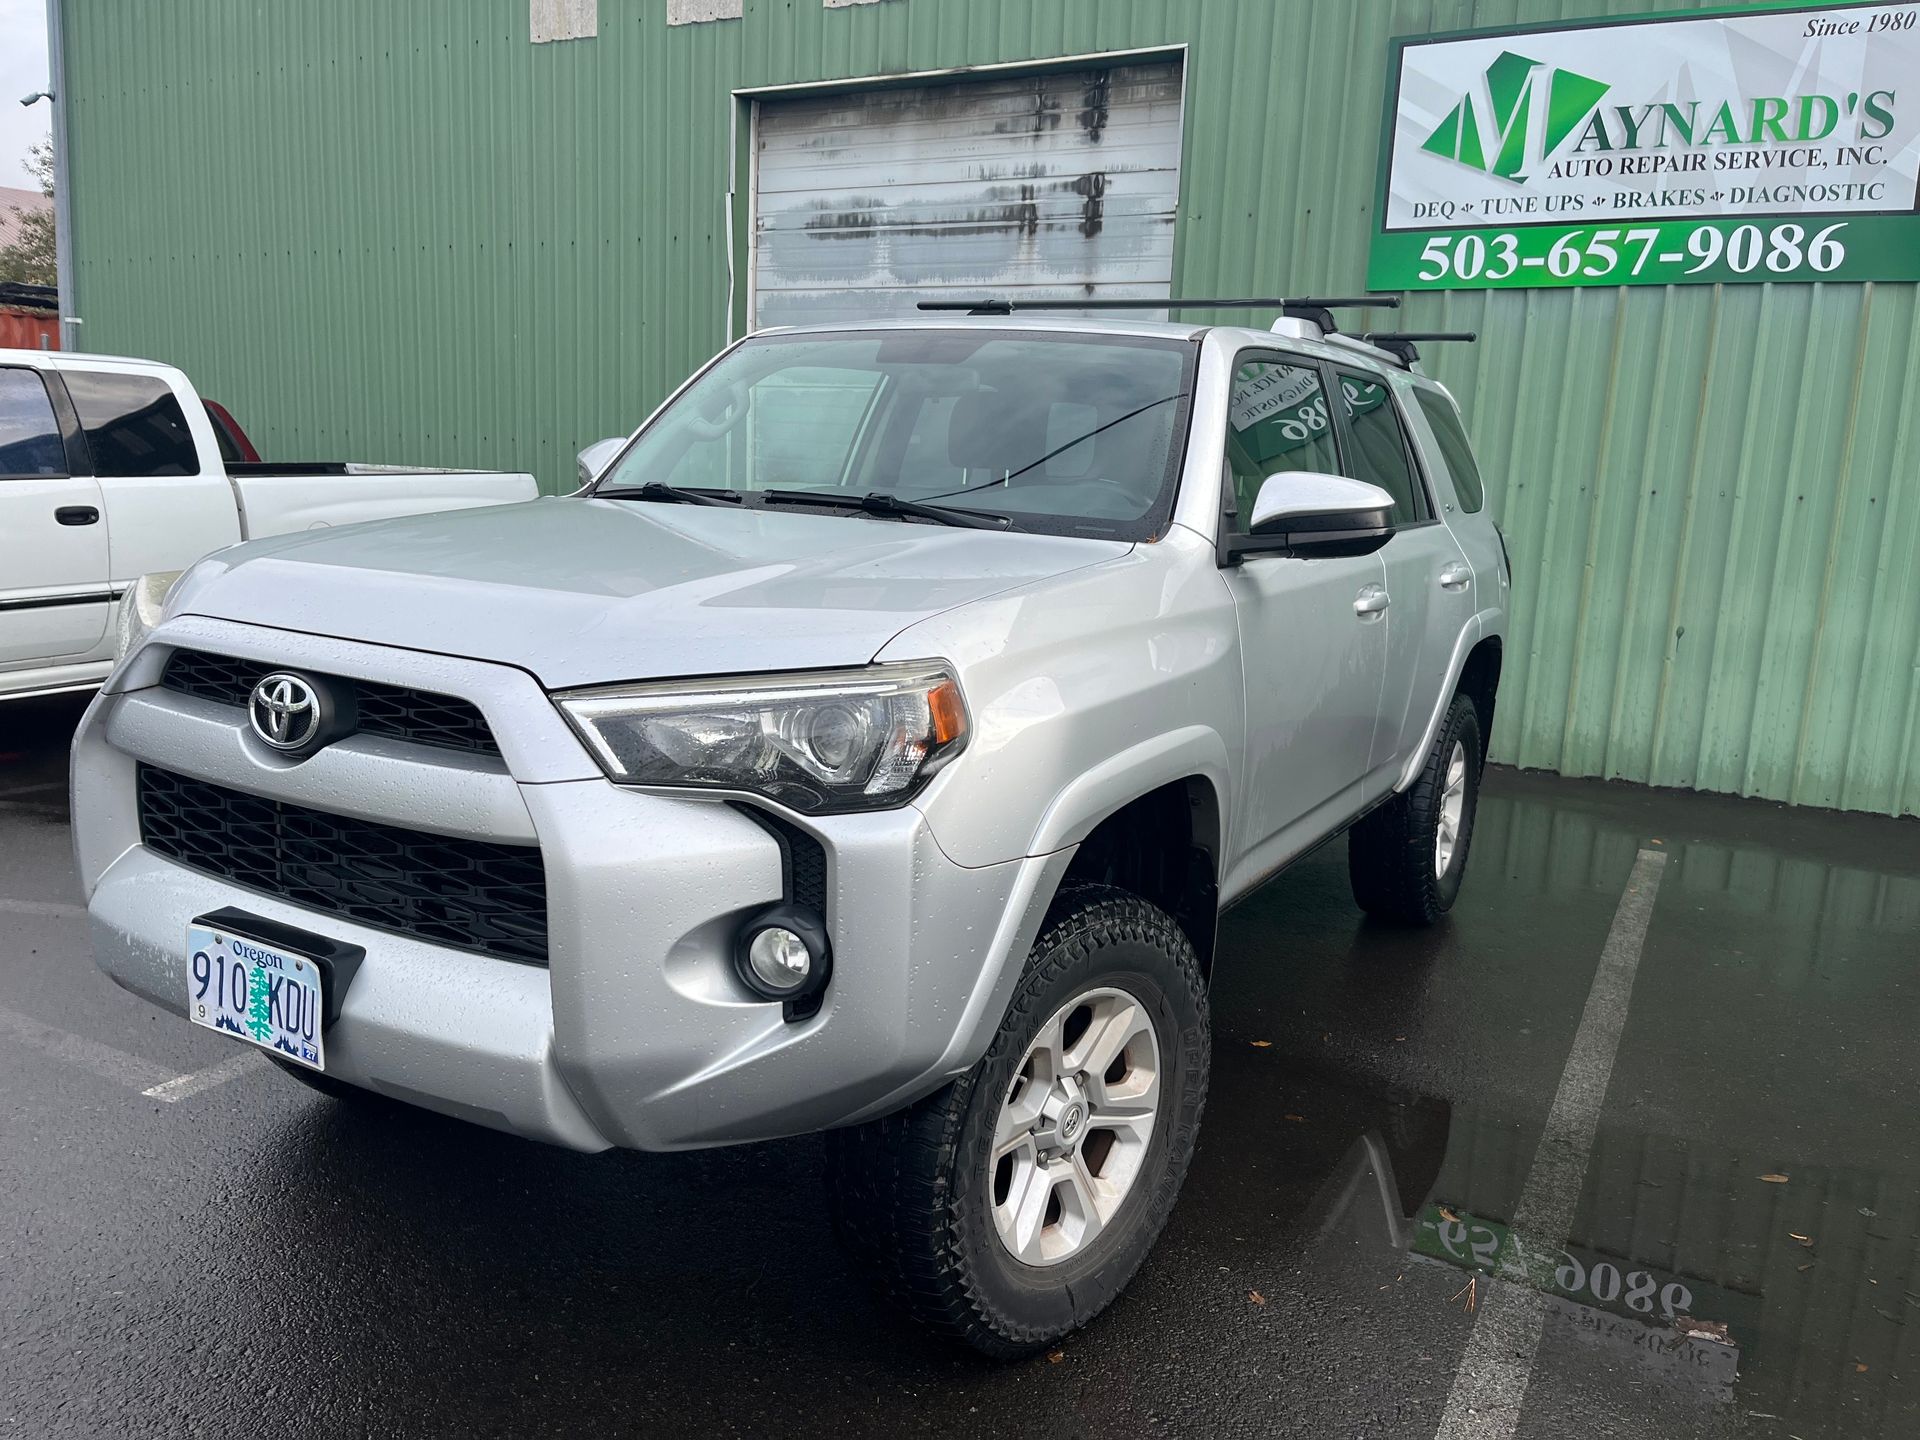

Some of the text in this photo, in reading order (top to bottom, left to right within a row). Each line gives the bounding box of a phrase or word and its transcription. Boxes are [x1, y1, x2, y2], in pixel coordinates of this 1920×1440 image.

[1803, 11, 1917, 38] Since 1980
[1547, 145, 1888, 179] AUTO REPAIR SERVICE, INC.
[1412, 182, 1886, 220] DEQ TUNE UPS BRAKES DIAGNOSTIC
[1418, 223, 1849, 281] 503-657-9086
[233, 940, 284, 971] Oregon
[192, 951, 316, 1041] 910 KDU
[198, 1004, 206, 1018] 9
[305, 1048, 316, 1061] 27
